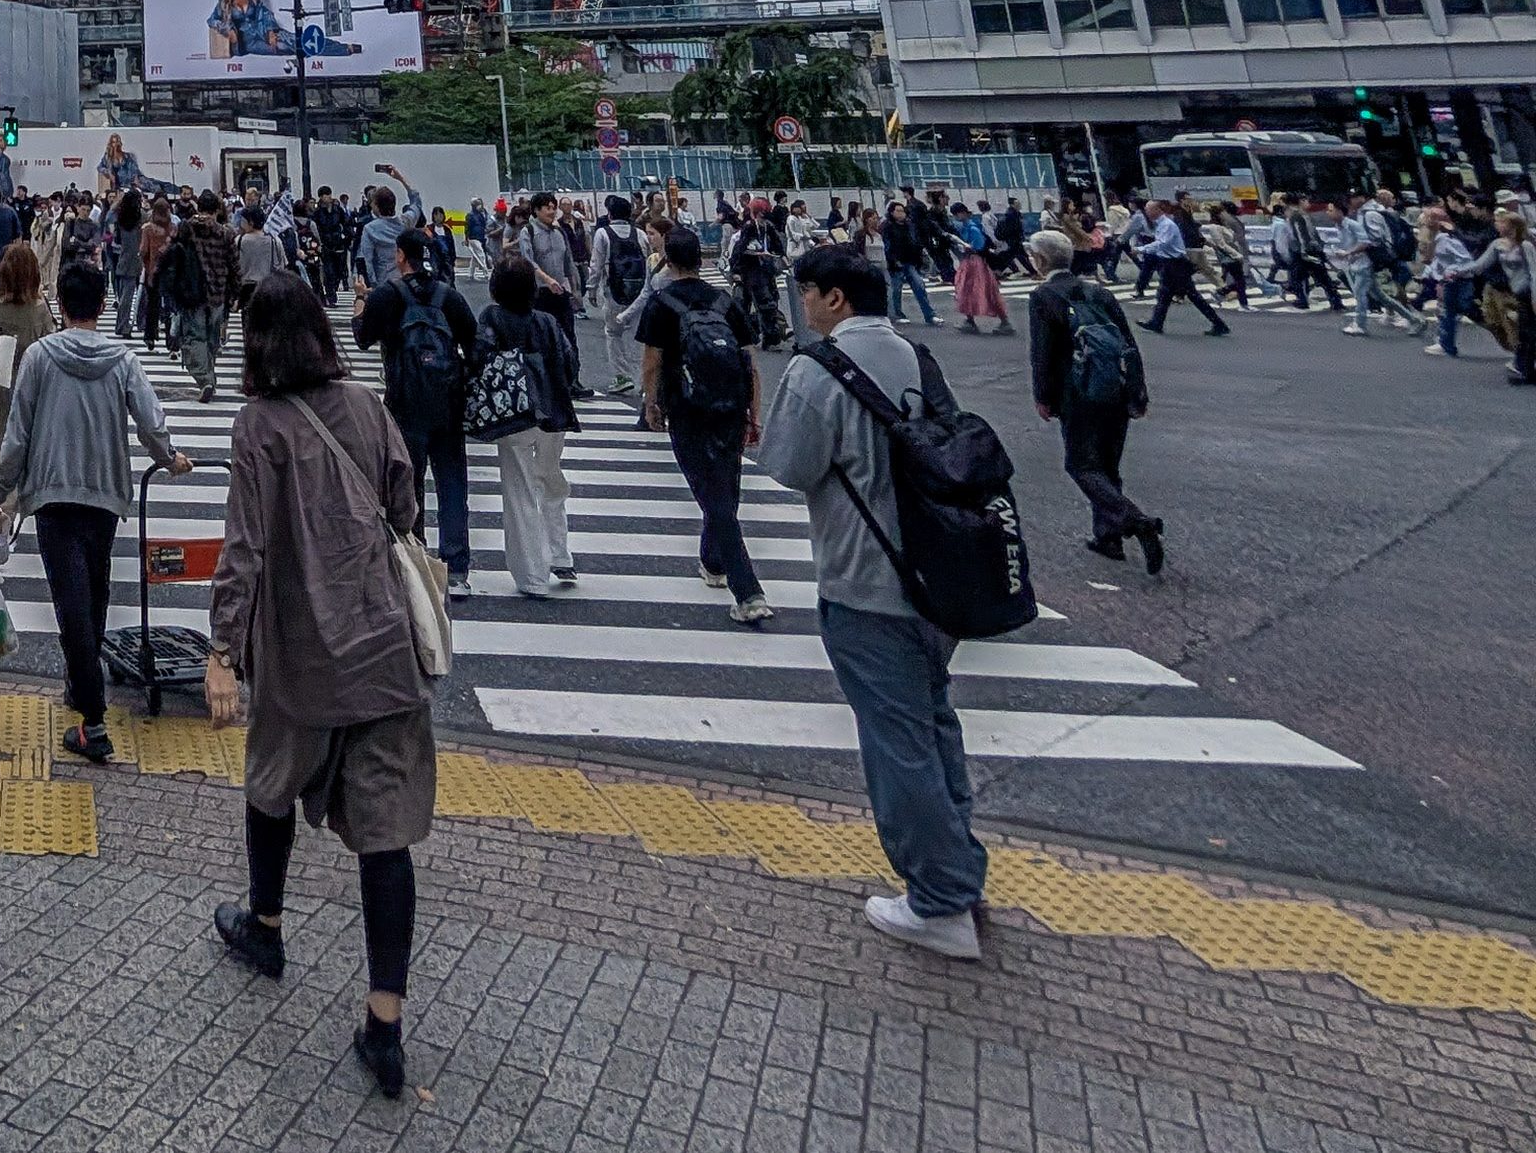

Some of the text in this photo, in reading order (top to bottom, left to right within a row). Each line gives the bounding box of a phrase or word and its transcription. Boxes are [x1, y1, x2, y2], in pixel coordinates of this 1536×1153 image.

[226, 63, 244, 73] FOR
[311, 60, 324, 70] AN
[394, 57, 417, 68] ICON
[984, 497, 1022, 595] EW ERA
